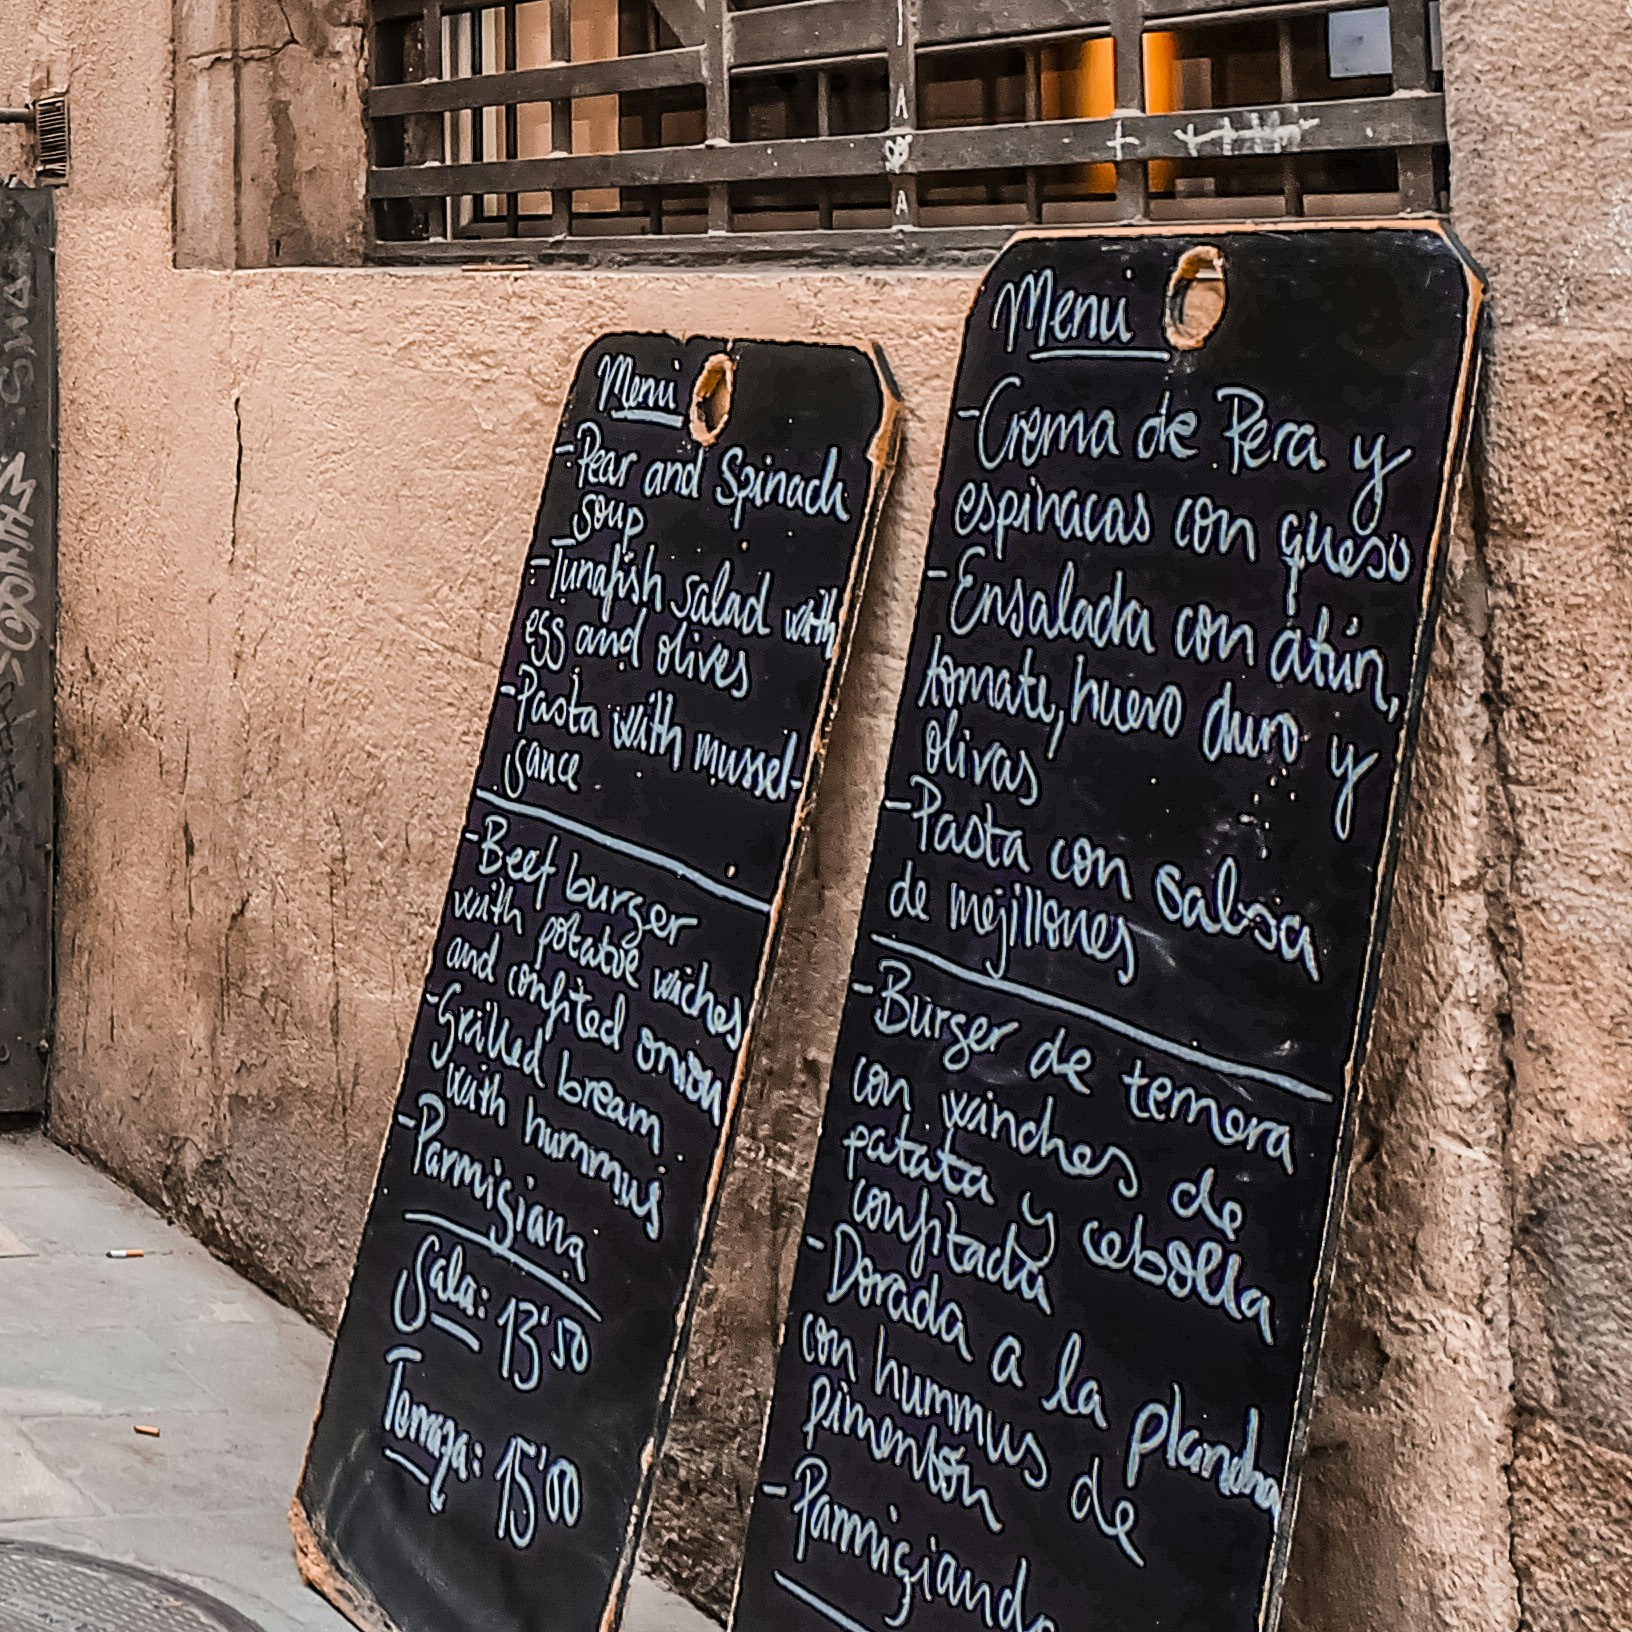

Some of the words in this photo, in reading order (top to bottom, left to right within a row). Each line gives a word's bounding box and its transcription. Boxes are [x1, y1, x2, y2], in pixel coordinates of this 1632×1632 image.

[572, 494, 644, 552] soup
[644, 446, 703, 499] and
[715, 446, 850, 530] Spinach
[1134, 390, 1201, 461] de
[1214, 386, 1328, 474] Pera
[1350, 432, 1415, 536] y
[953, 475, 1152, 561] espinacas
[1173, 492, 1257, 562] con
[1278, 510, 1413, 616] queso
[525, 608, 565, 671] egg
[575, 607, 647, 668] and
[657, 621, 748, 698] olives
[671, 560, 771, 635] salad
[785, 588, 837, 659] with
[1173, 603, 1255, 669] con
[505, 739, 580, 798] sauce
[613, 692, 682, 770] with
[925, 708, 1039, 807] olivas
[1070, 653, 1185, 737] huevo
[1200, 679, 1301, 763] duro
[1329, 734, 1381, 842] y
[454, 878, 522, 934] with
[566, 853, 698, 950] burger
[888, 860, 930, 922] de
[949, 881, 1137, 987] mejillones
[1049, 837, 1134, 903] con
[1153, 855, 1321, 983] salsa
[446, 932, 501, 983] and
[508, 964, 626, 1050] confited
[637, 1027, 722, 1127] onion
[445, 1061, 507, 1126] with
[523, 1097, 662, 1241] hummus
[557, 1048, 662, 1156] bream
[852, 1055, 912, 1112] con
[1170, 1166, 1243, 1242] de
[1027, 1025, 1094, 1096] de
[1121, 1058, 1294, 1175] ternera
[392, 1234, 490, 1334] Sala:
[842, 1113, 996, 1205] patata
[1020, 1190, 1058, 1268] y
[1081, 1212, 1275, 1346] cebolla
[852, 1178, 1052, 1315] confitada
[802, 1312, 856, 1382] con
[874, 1323, 1048, 1490] hummus
[1068, 1456, 1146, 1568] de
[990, 1332, 1024, 1388] a
[1039, 1330, 1109, 1430] la
[1127, 1382, 1281, 1532] plancha
